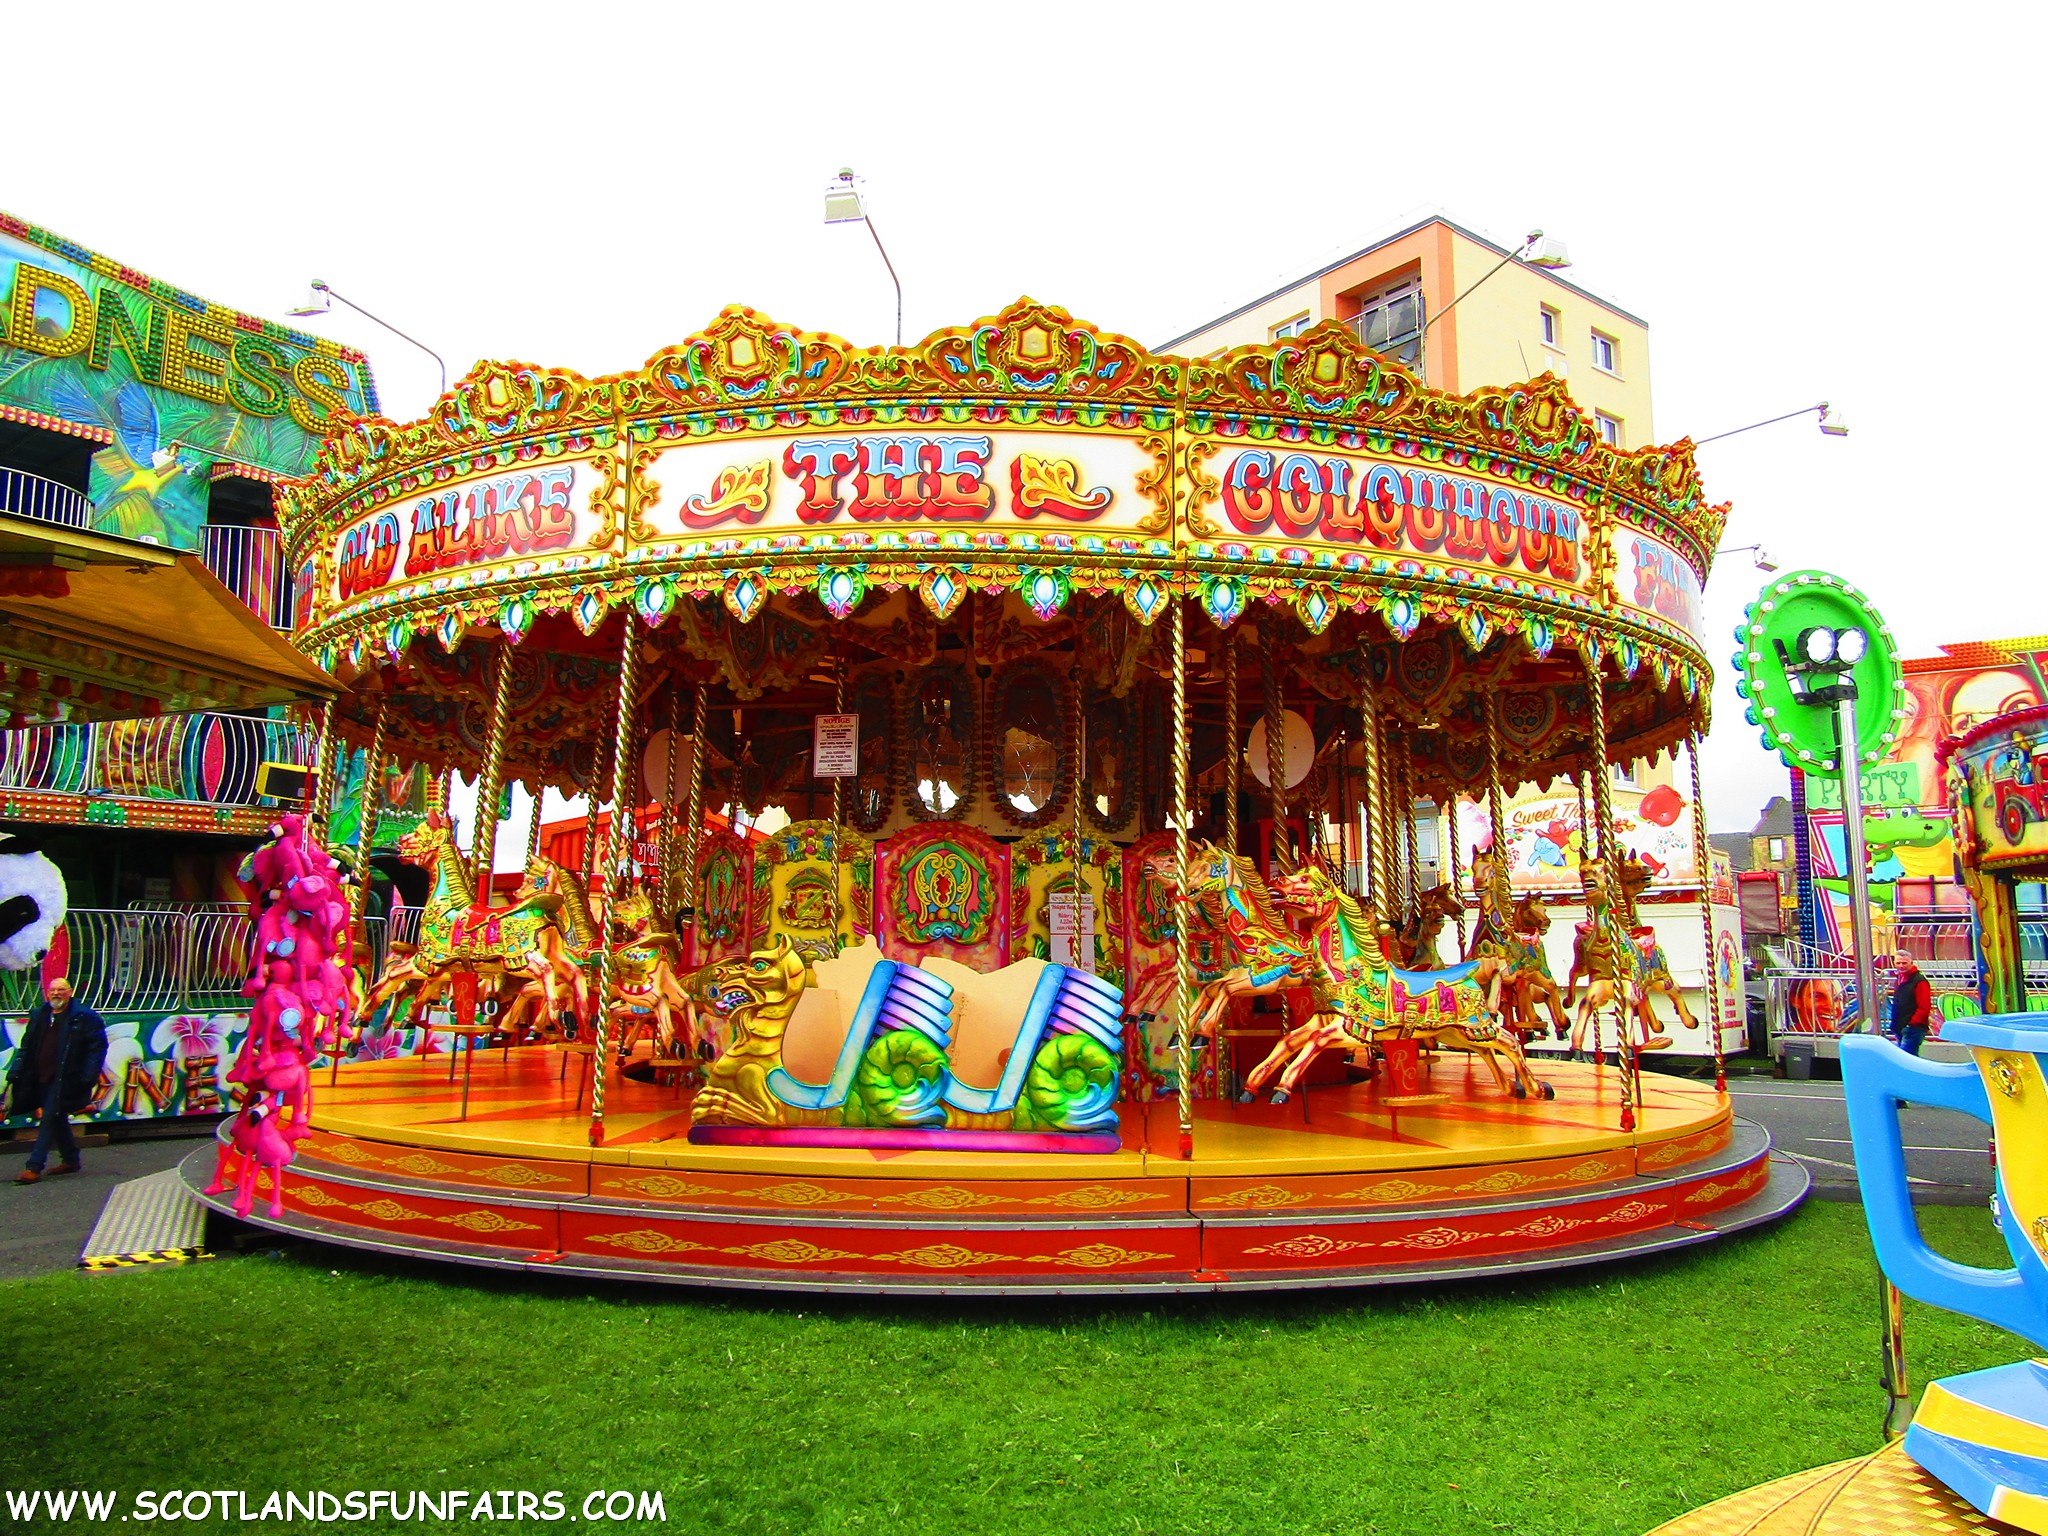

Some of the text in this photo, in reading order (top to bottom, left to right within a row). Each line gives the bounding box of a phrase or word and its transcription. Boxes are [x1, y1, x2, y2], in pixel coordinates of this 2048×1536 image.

[0, 261, 351, 435] DNESS
[783, 436, 995, 524] THE
[1221, 449, 1584, 582] COLQUHOUN
[338, 512, 400, 601] OLD
[404, 465, 577, 578] ALIKE
[823, 717, 851, 725] NOTICE
[1512, 804, 1558, 828] Sweet
[1820, 770, 1909, 804] PRTY
